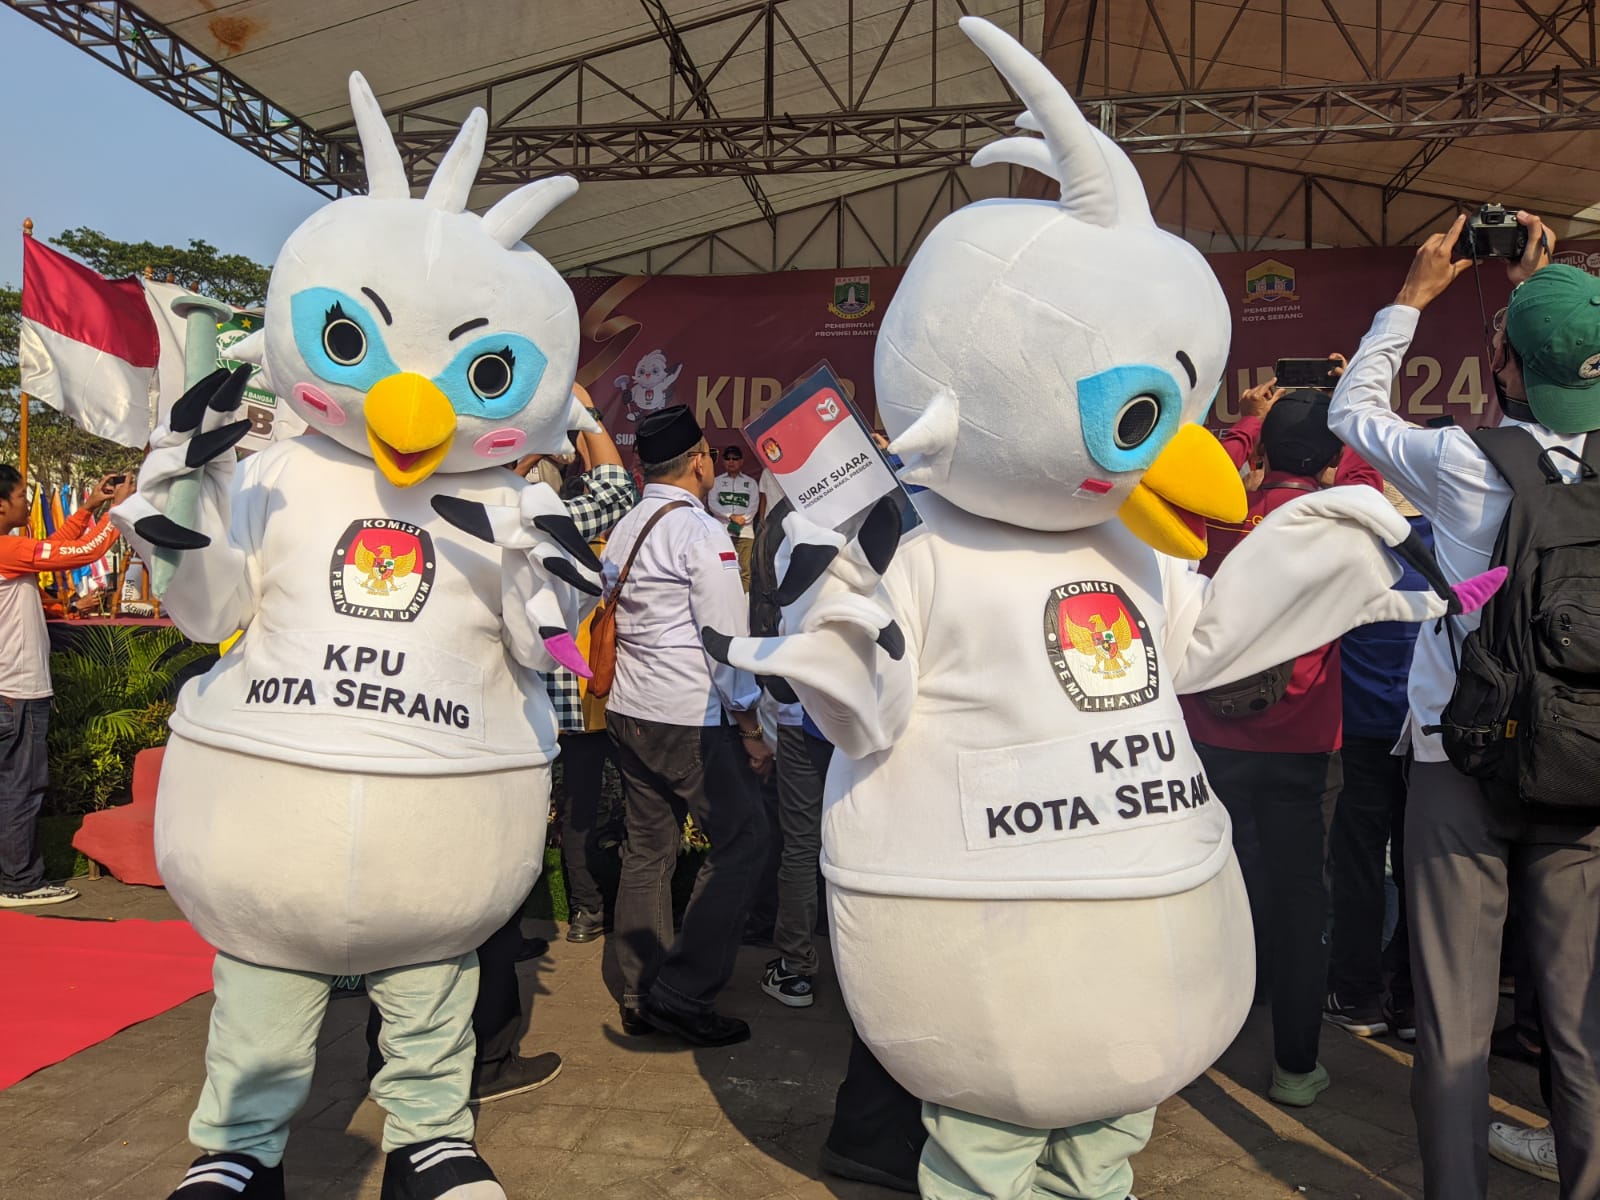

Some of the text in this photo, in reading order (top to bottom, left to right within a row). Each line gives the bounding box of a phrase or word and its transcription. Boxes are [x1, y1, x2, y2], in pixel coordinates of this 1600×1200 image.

[1243, 304, 1301, 314] PEMERINTAH
[1267, 312, 1304, 321] SERANG
[247, 390, 274, 404] BANGSA
[1390, 356, 1489, 415] 24
[798, 452, 870, 504] SURAT SUARA
[823, 487, 834, 497] DAN
[849, 460, 873, 478] PRESIDEN
[333, 519, 430, 620] KOMISI PEMILIHAN UMUM
[323, 644, 406, 677] KPU
[1054, 582, 1158, 709] KOMISI PEMILIHAN UMUM
[245, 678, 470, 729] KOTA SERANG
[1089, 730, 1176, 774] KPU
[986, 770, 1210, 838] KOTA SERAN
